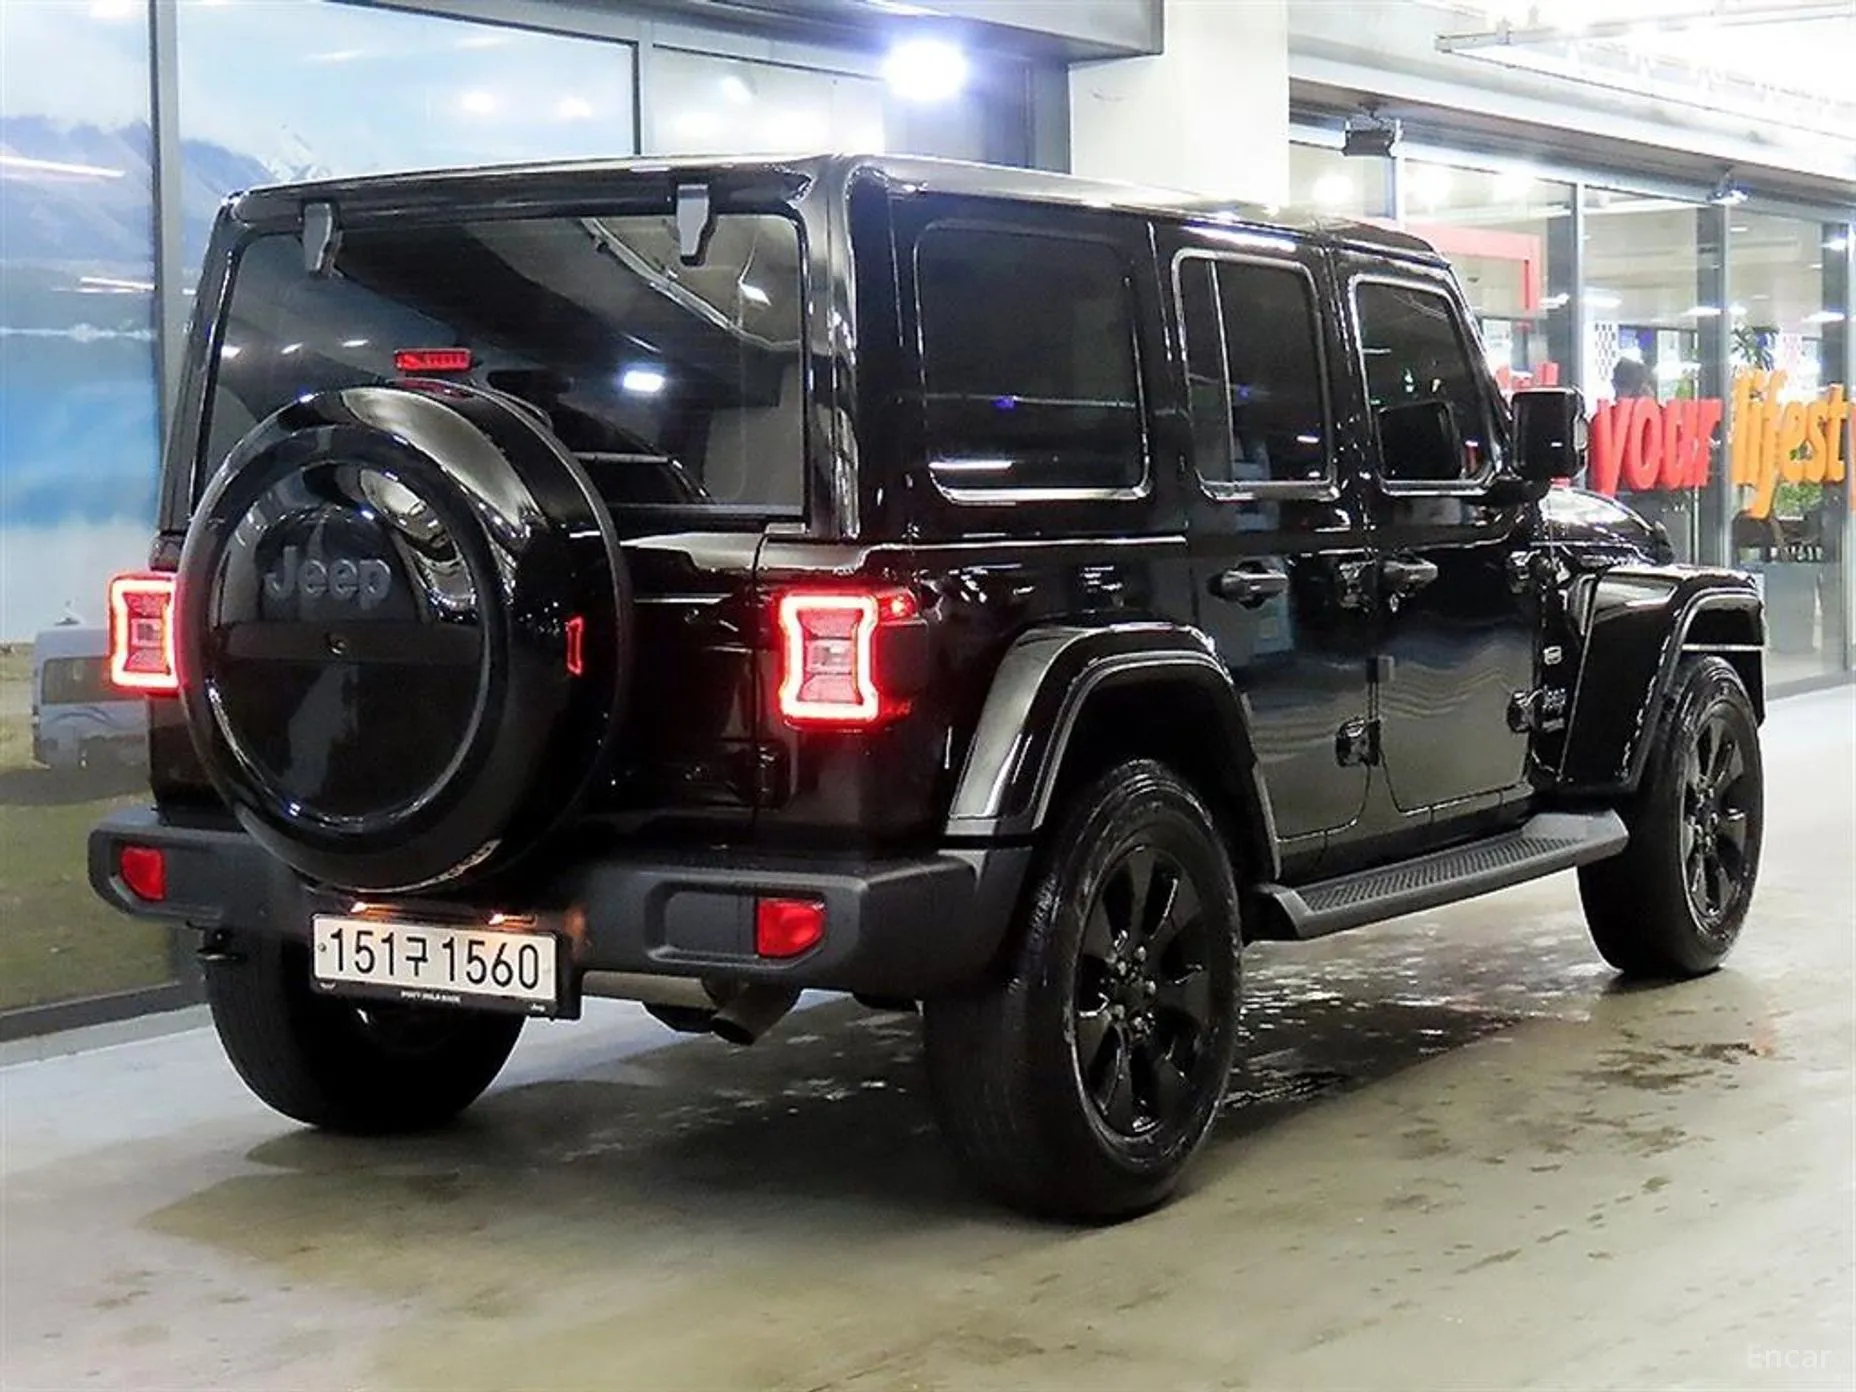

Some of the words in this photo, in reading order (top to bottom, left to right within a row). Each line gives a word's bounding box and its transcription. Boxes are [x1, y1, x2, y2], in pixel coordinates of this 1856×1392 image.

[1591, 397, 1721, 499] your
[1732, 365, 1856, 519] lifest
[264, 546, 391, 610] Jeep
[442, 936, 539, 990] 1560
